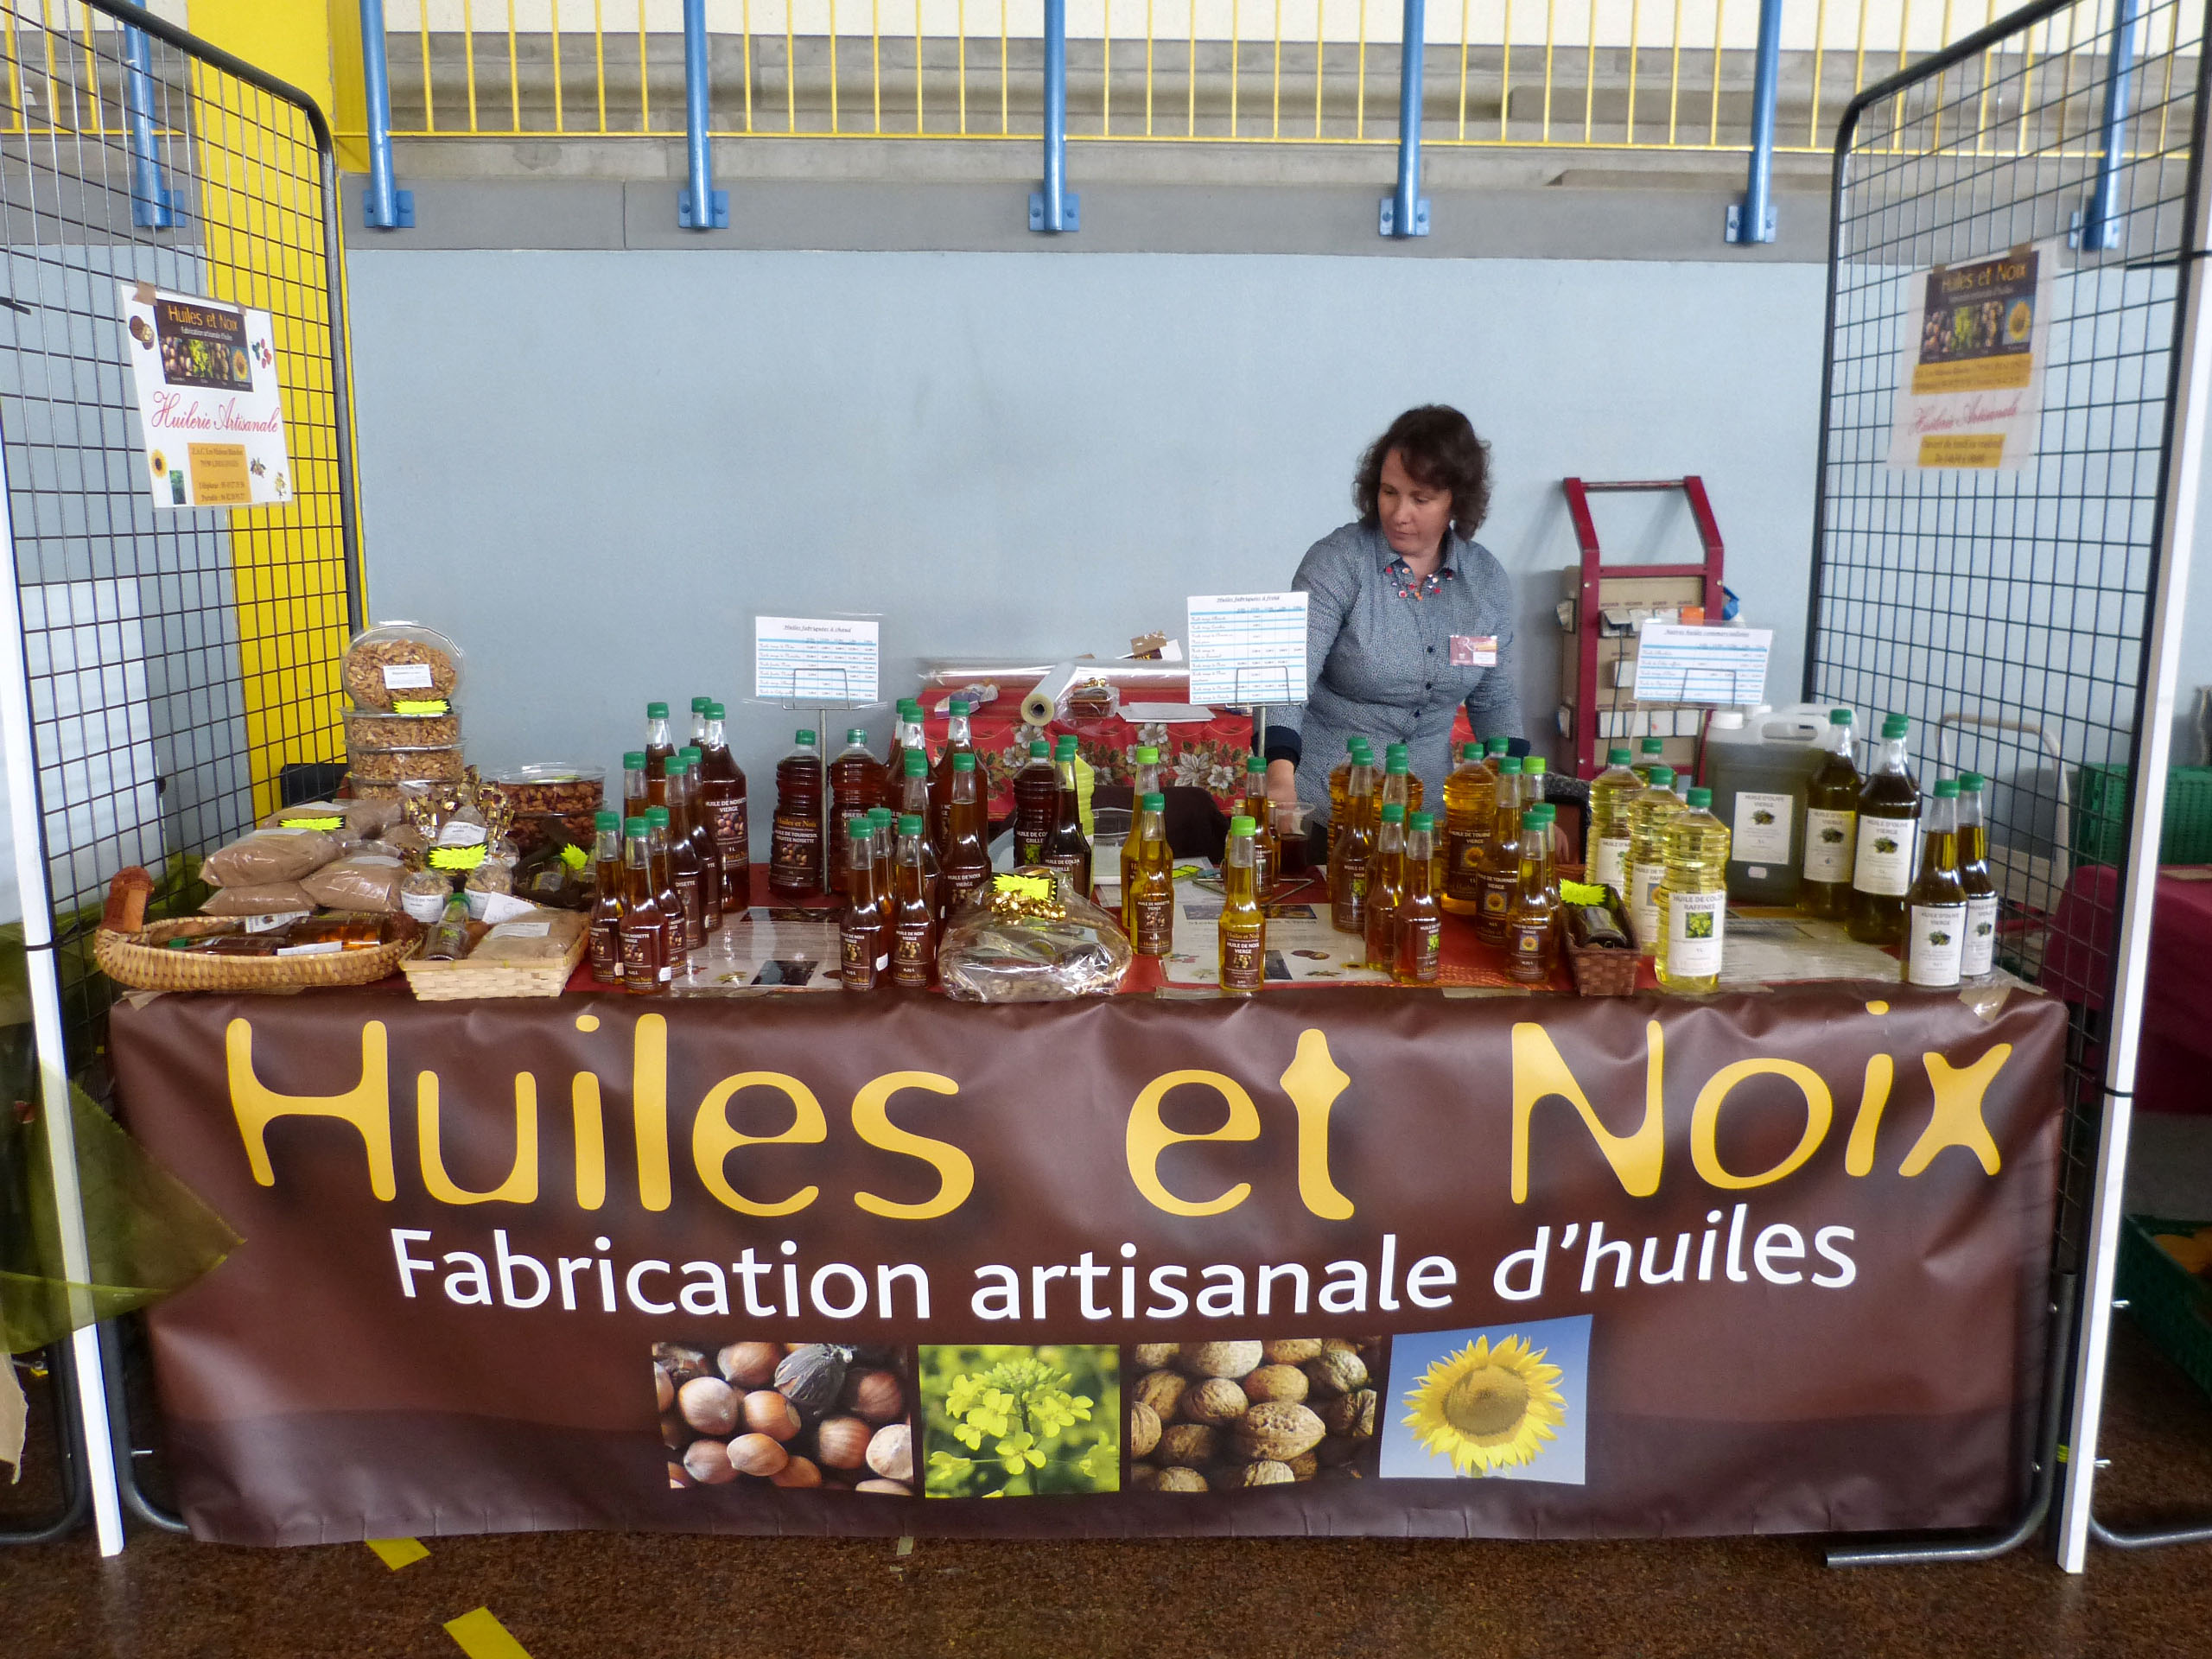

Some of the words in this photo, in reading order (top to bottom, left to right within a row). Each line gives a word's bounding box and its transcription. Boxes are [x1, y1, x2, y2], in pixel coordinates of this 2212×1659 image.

[168, 304, 203, 326] Huiles
[207, 312, 217, 328] et
[219, 315, 238, 332] Noix
[151, 391, 211, 428] Huilerie
[213, 397, 280, 432] Artisanale
[226, 1014, 974, 1219] Huiles
[1127, 1028, 1354, 1220] et
[1512, 1001, 2012, 1204] Noix
[391, 1229, 930, 1319] Fabrication
[971, 1243, 1456, 1319] artisanale
[1494, 1204, 1856, 1300] d'huiles
